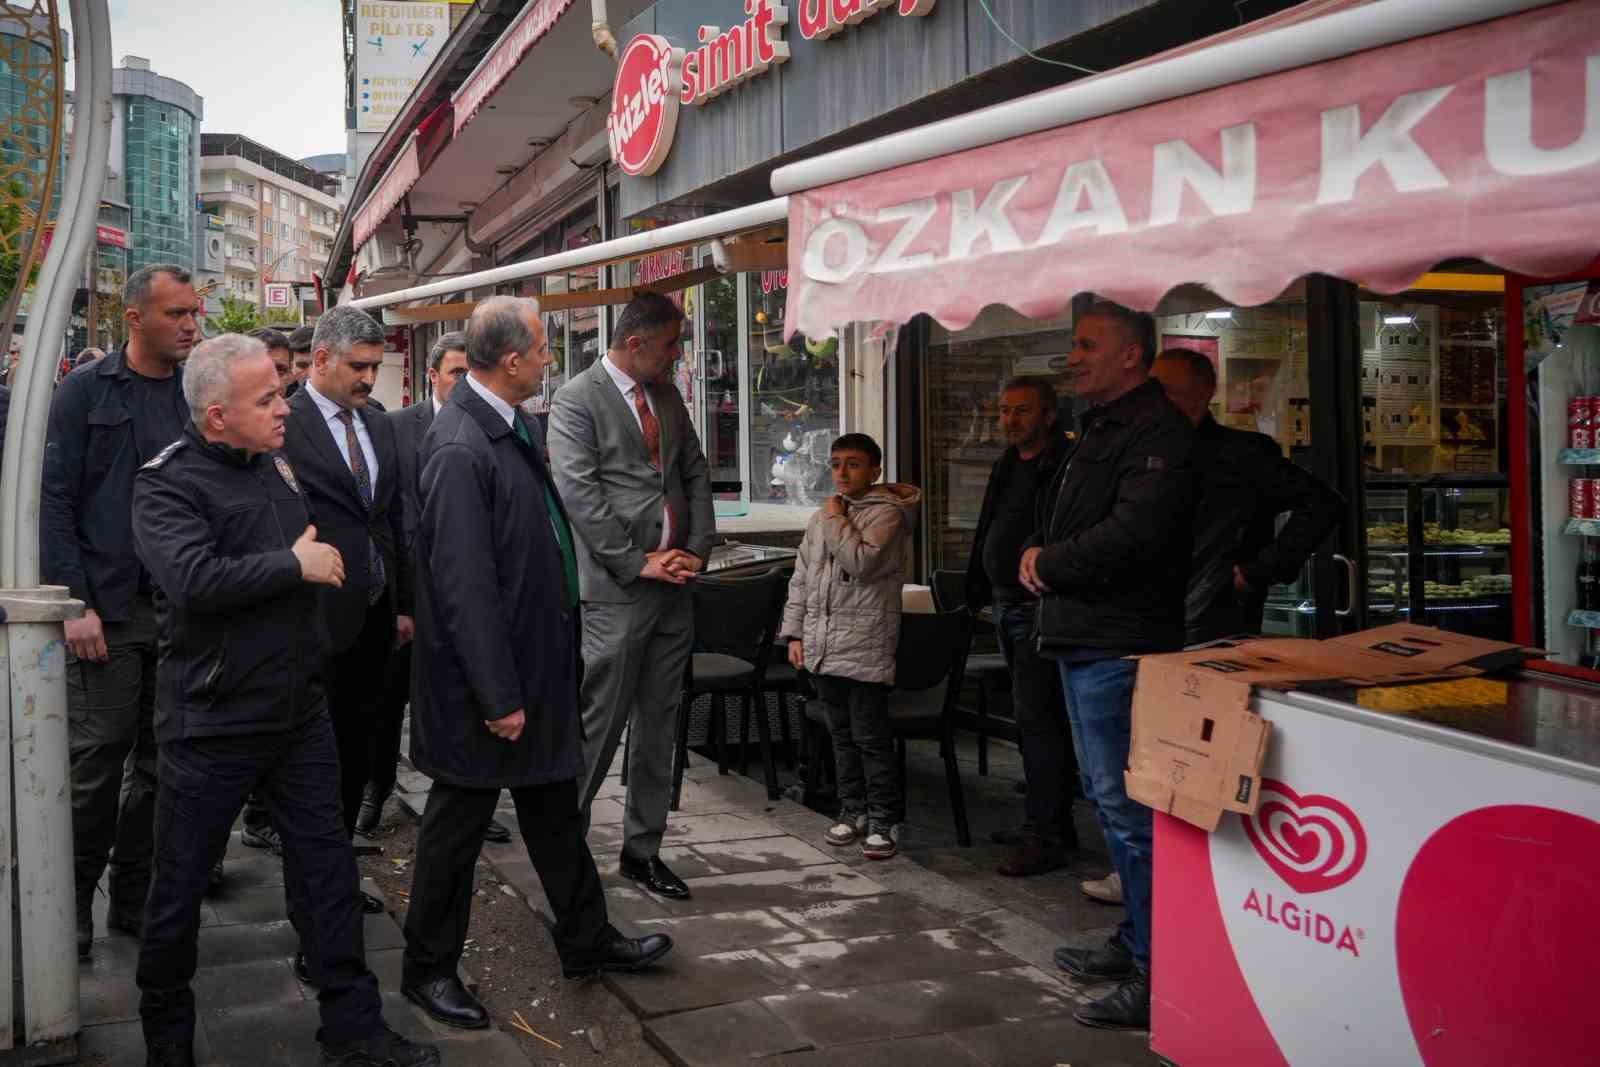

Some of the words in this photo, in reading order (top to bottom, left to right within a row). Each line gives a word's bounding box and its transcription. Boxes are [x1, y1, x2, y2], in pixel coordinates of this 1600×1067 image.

[369, 22, 433, 36] PILATES
[680, 0, 775, 105] simit
[802, 120, 1256, 284] ÖZKAN
[271, 290, 285, 302] E
